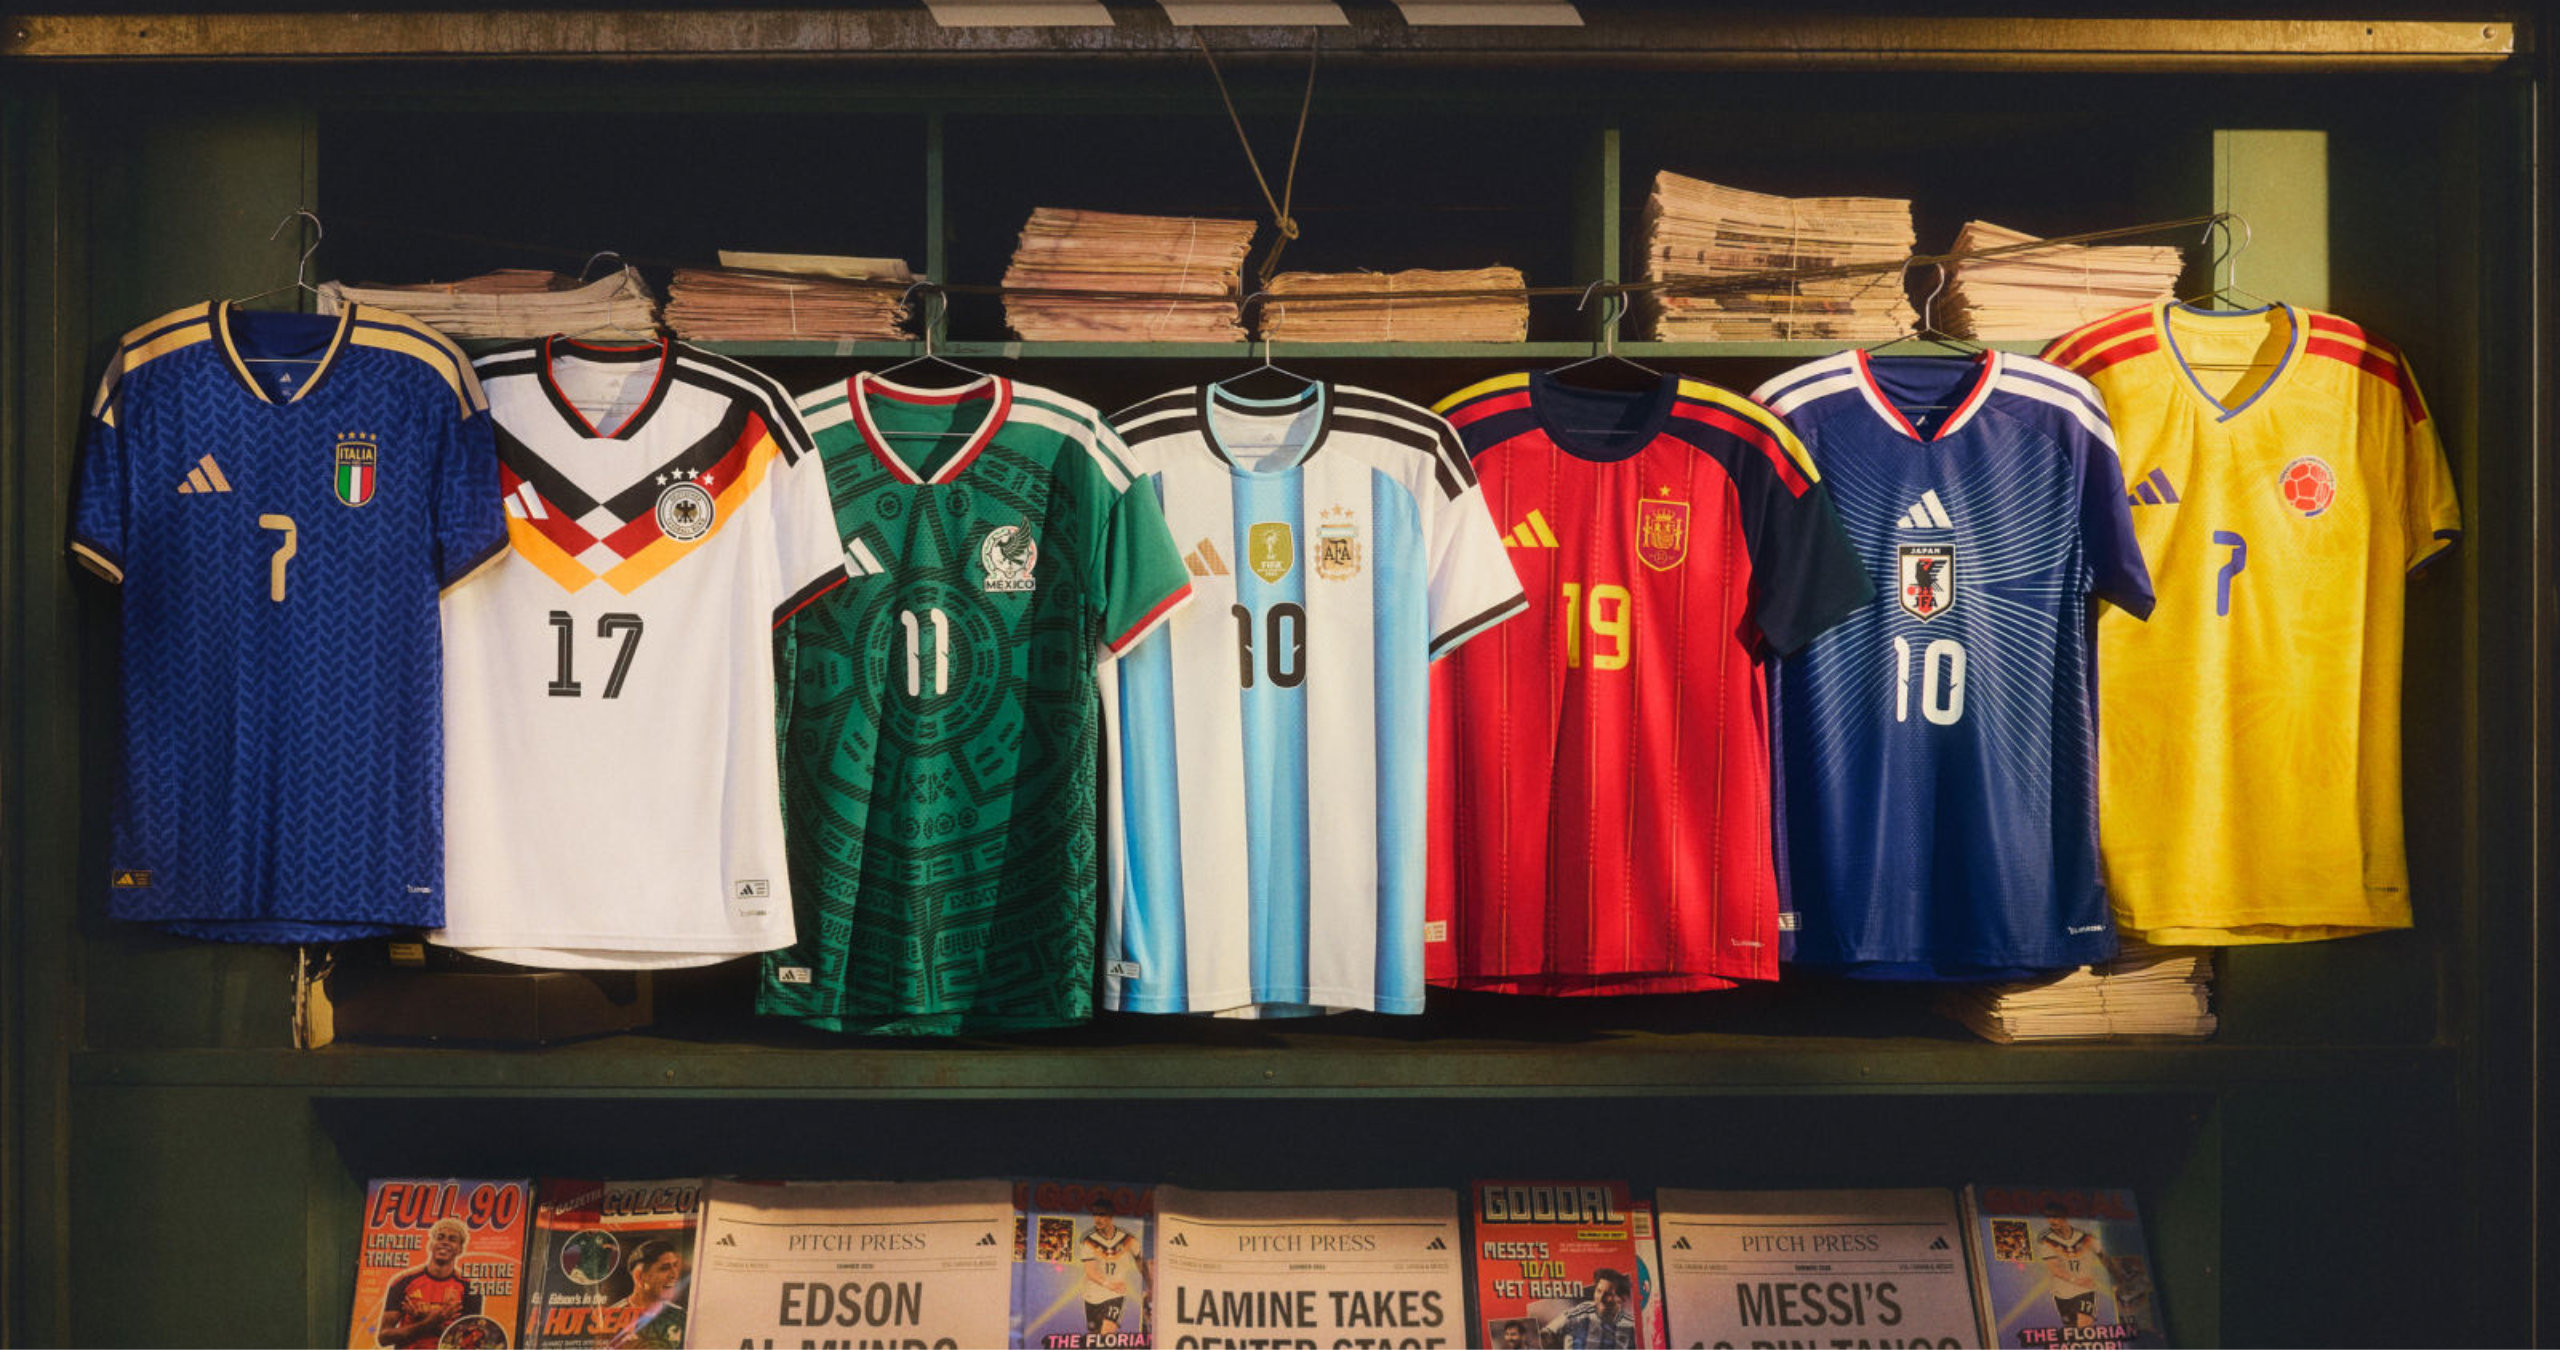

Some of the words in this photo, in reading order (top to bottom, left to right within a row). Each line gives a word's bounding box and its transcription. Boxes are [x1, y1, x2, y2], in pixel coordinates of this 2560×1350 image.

[338, 448, 374, 461] ITALIA
[258, 513, 298, 602] 7
[1323, 538, 1352, 565] AFA
[2212, 530, 2247, 617] 7
[1913, 595, 1938, 608] JFA
[1562, 582, 1632, 671] 19
[548, 610, 644, 699] 17
[900, 607, 949, 697] 11
[1231, 602, 1307, 688] 10
[1893, 635, 1967, 726] 10
[372, 1184, 460, 1229] FULL
[468, 1185, 521, 1231] 90
[1482, 1186, 1626, 1224] GOOOAL
[367, 1233, 423, 1250] LAMINE
[788, 1234, 852, 1251] PITCH
[860, 1233, 927, 1250] PRESS
[1239, 1235, 1301, 1252] PITCH
[1311, 1235, 1376, 1251] PRESS
[1483, 1241, 1549, 1260] MESSI'S
[1741, 1235, 1804, 1252] PITCH
[1813, 1234, 1880, 1251] PRESS
[366, 1250, 410, 1268] TAKES
[461, 1263, 515, 1279] CENTRE
[1520, 1261, 1565, 1278] 10/10
[468, 1280, 513, 1296] STAGE
[1494, 1280, 1524, 1298] YET
[1529, 1280, 1585, 1299] AGAIN
[779, 1282, 922, 1327] EDSON
[1176, 1287, 1317, 1329] LAMINE
[1328, 1291, 1444, 1329] TAKES
[1736, 1282, 1902, 1327] MESSI’S
[1049, 1334, 1081, 1349] THE
[2022, 1328, 2058, 1343] THE
[2063, 1325, 2138, 1340] FLORIAN
